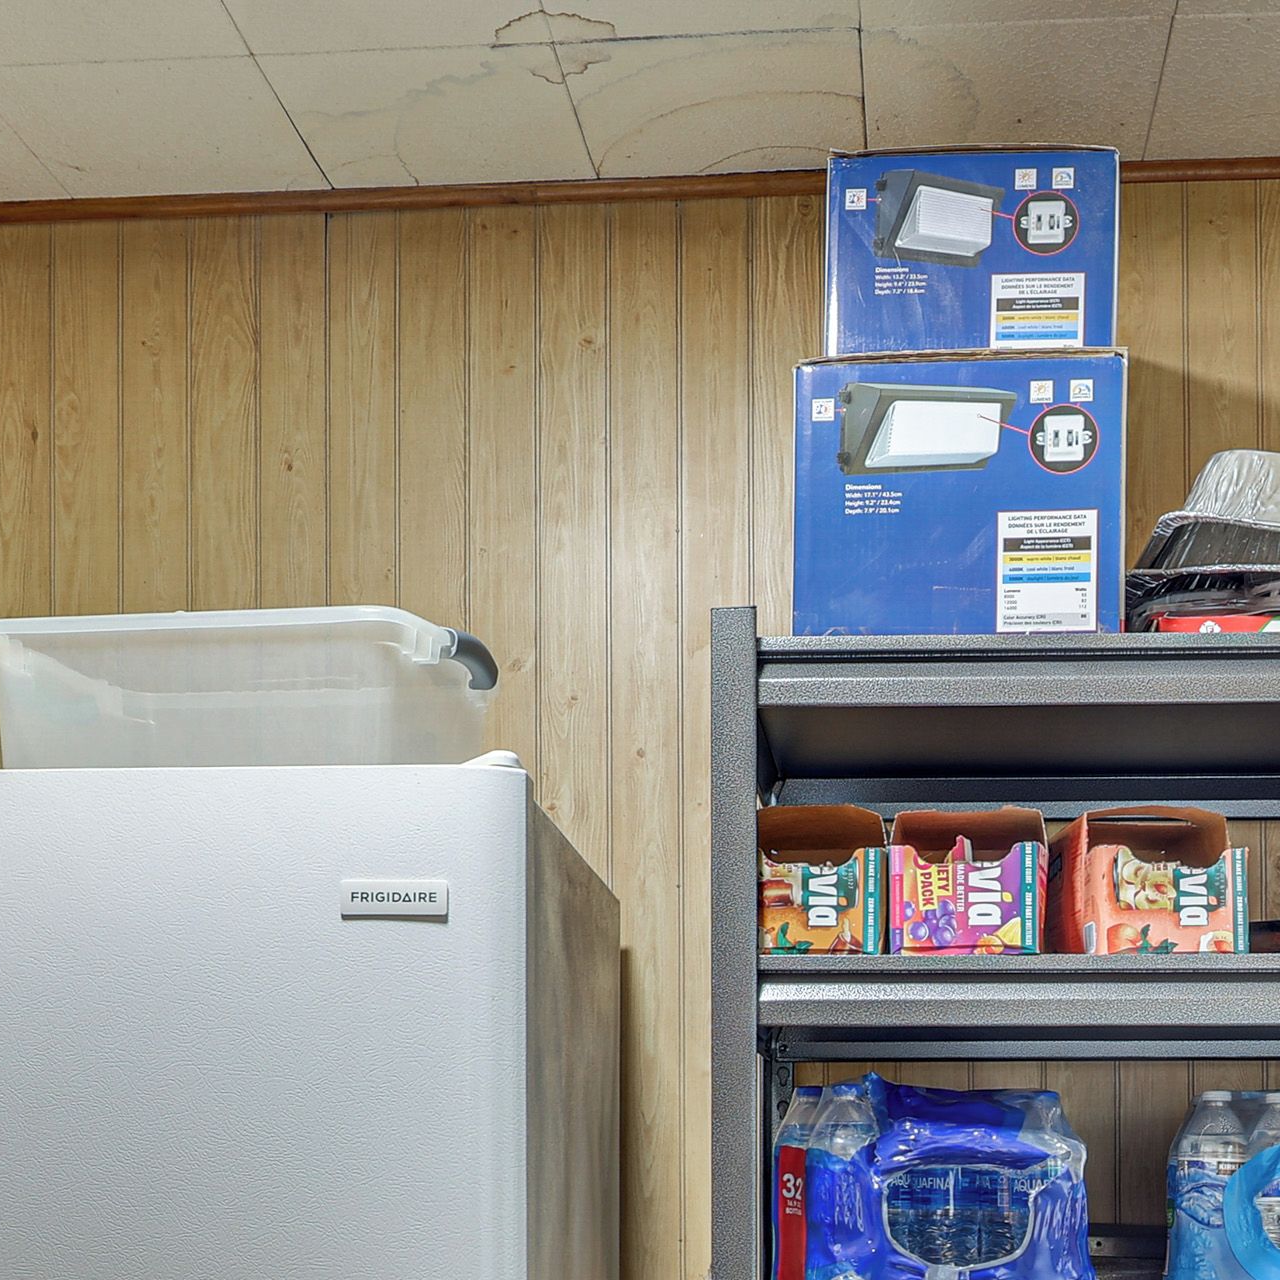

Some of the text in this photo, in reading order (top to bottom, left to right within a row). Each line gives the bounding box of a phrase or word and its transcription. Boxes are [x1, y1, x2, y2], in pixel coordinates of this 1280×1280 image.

[350, 892, 437, 903] FRIGIDAIRE
[920, 871, 936, 908] PACK
[956, 864, 966, 912] MADE BETTER
[782, 1173, 803, 1200] 32
